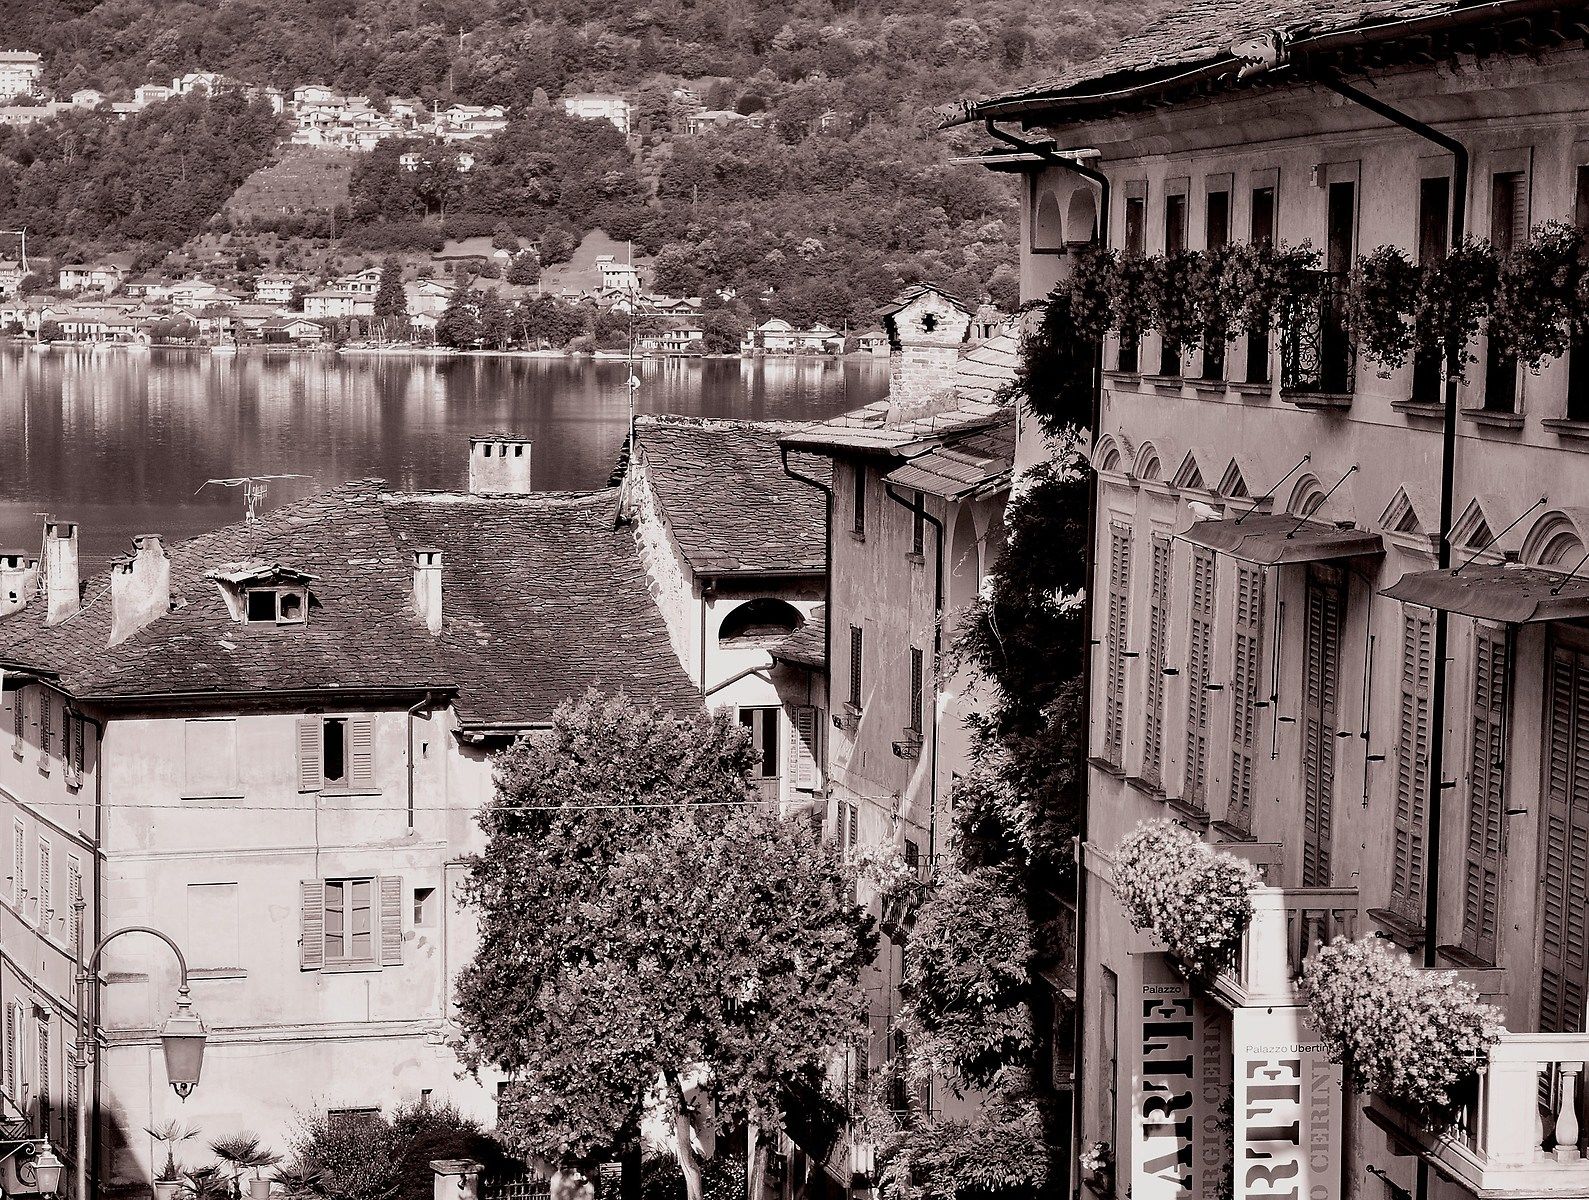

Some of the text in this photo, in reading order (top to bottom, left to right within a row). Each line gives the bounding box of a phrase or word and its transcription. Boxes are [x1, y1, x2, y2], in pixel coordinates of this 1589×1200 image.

[1143, 986, 1182, 994] Palazzo
[1203, 1005, 1221, 1104] CERIN
[1246, 1044, 1330, 1054] Palazzo Ubertin
[1311, 1059, 1331, 1174] CERINI
